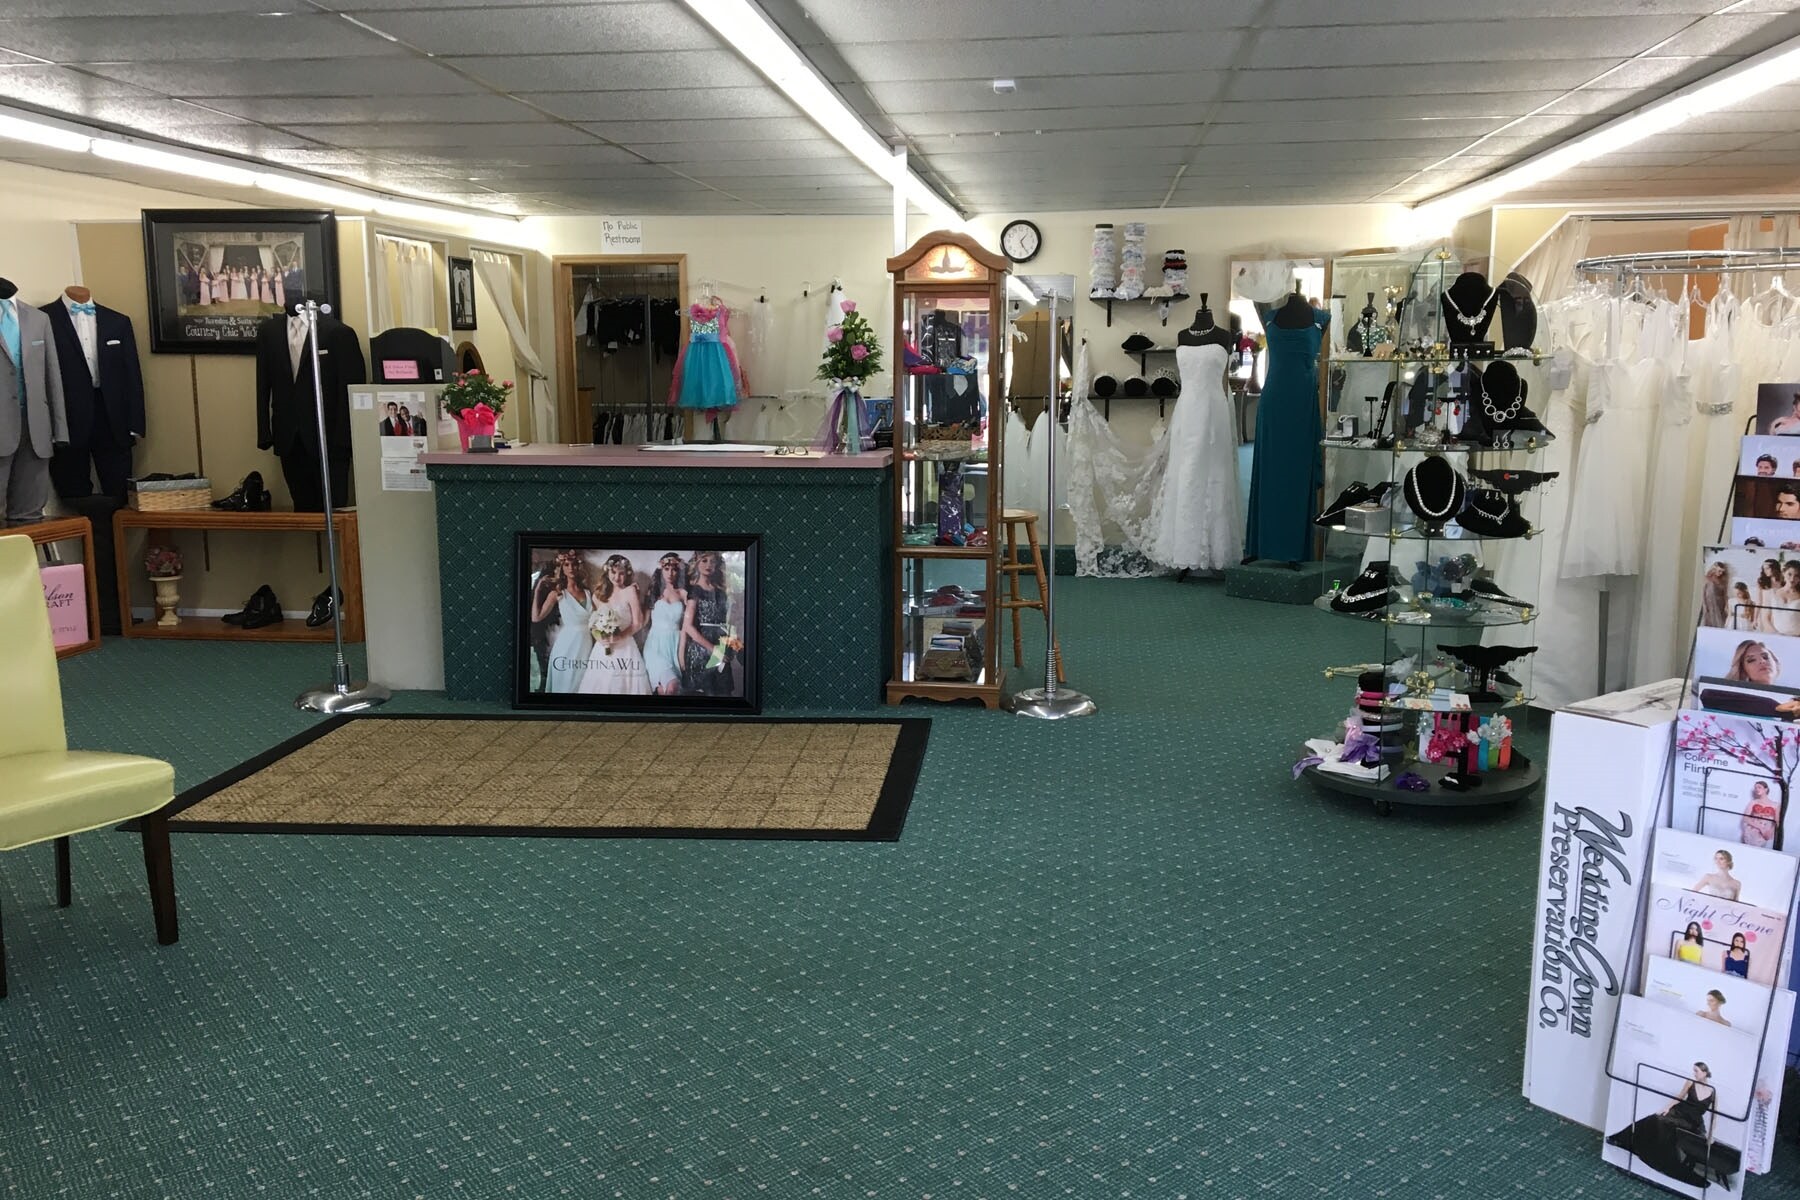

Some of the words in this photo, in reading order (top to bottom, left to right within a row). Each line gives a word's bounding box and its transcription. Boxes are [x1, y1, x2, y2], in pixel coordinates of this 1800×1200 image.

[602, 221, 614, 231] No
[617, 220, 638, 230] Public
[185, 325, 220, 340] Country
[221, 325, 239, 337] Chic
[552, 656, 615, 672] CHRISTINA
[615, 657, 641, 671] WU
[1683, 762, 1712, 778] Flirty
[1684, 752, 1710, 763] Color
[1713, 758, 1729, 767] me
[1569, 806, 1633, 945] Wedding
[1541, 801, 1580, 985] Preservation
[1656, 896, 1717, 922] Night
[1721, 911, 1774, 935] Scene
[1554, 937, 1619, 1038] Gown
[1538, 985, 1568, 1029] Co.
